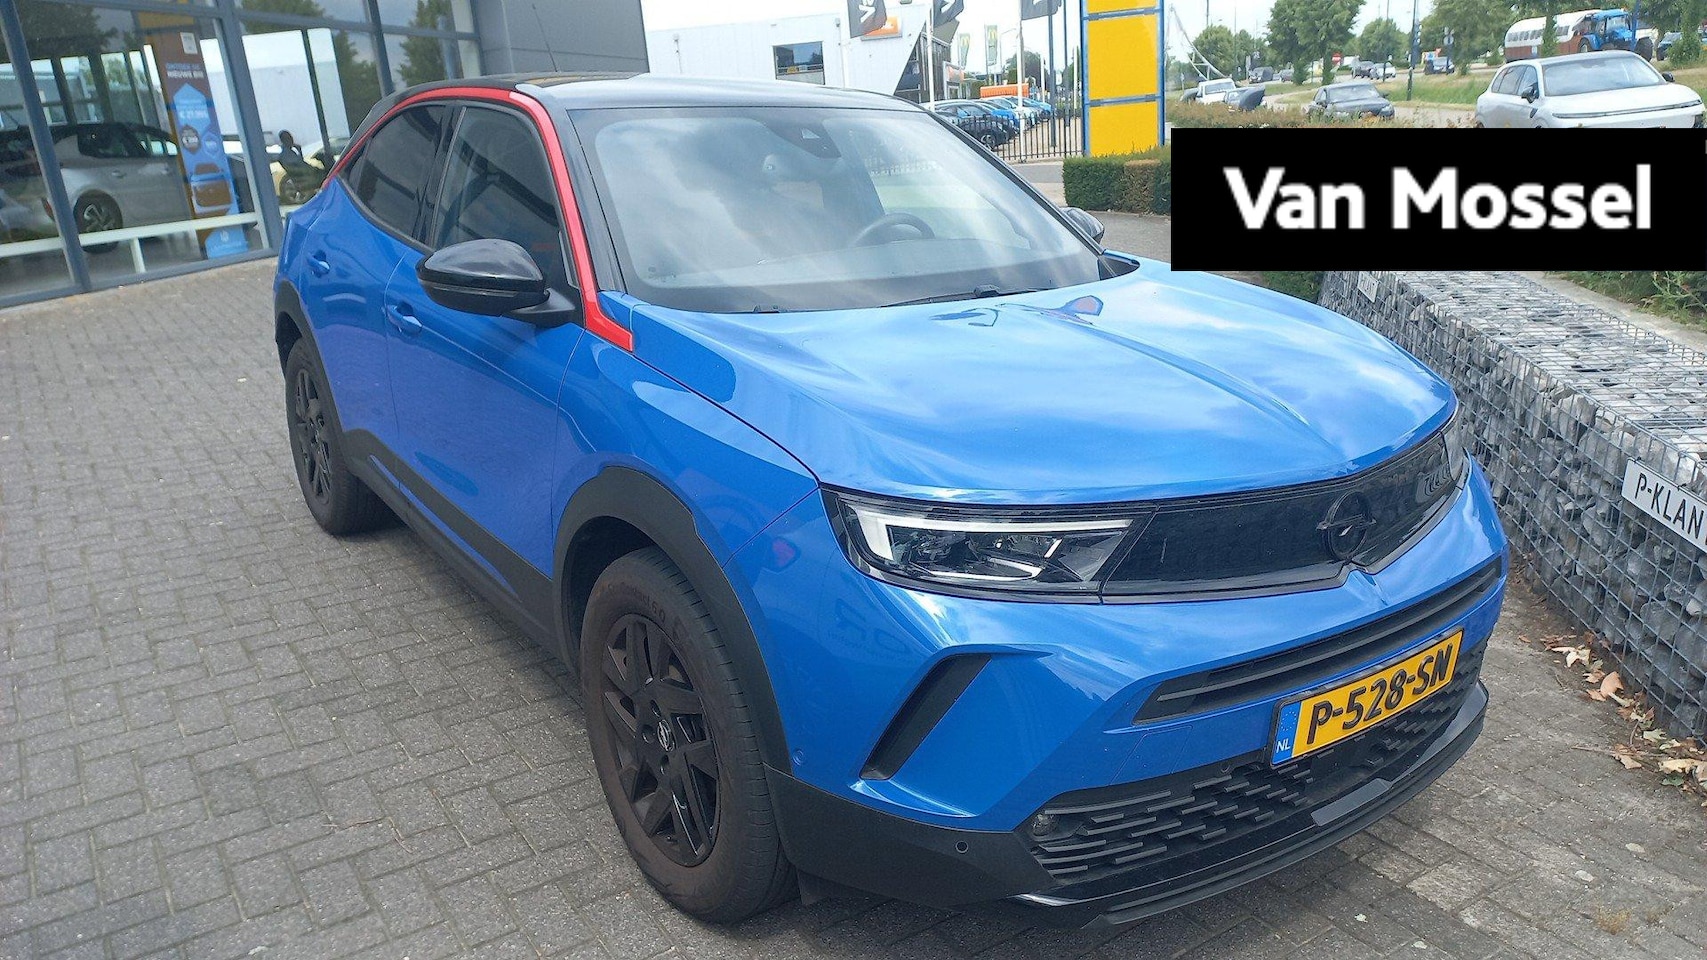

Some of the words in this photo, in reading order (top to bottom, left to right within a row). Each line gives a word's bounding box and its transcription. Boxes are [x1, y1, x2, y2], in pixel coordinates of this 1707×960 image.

[1634, 472, 1707, 545] P-KLAN
[1306, 643, 1453, 745] P-528-SN
[1275, 738, 1291, 753] NL
